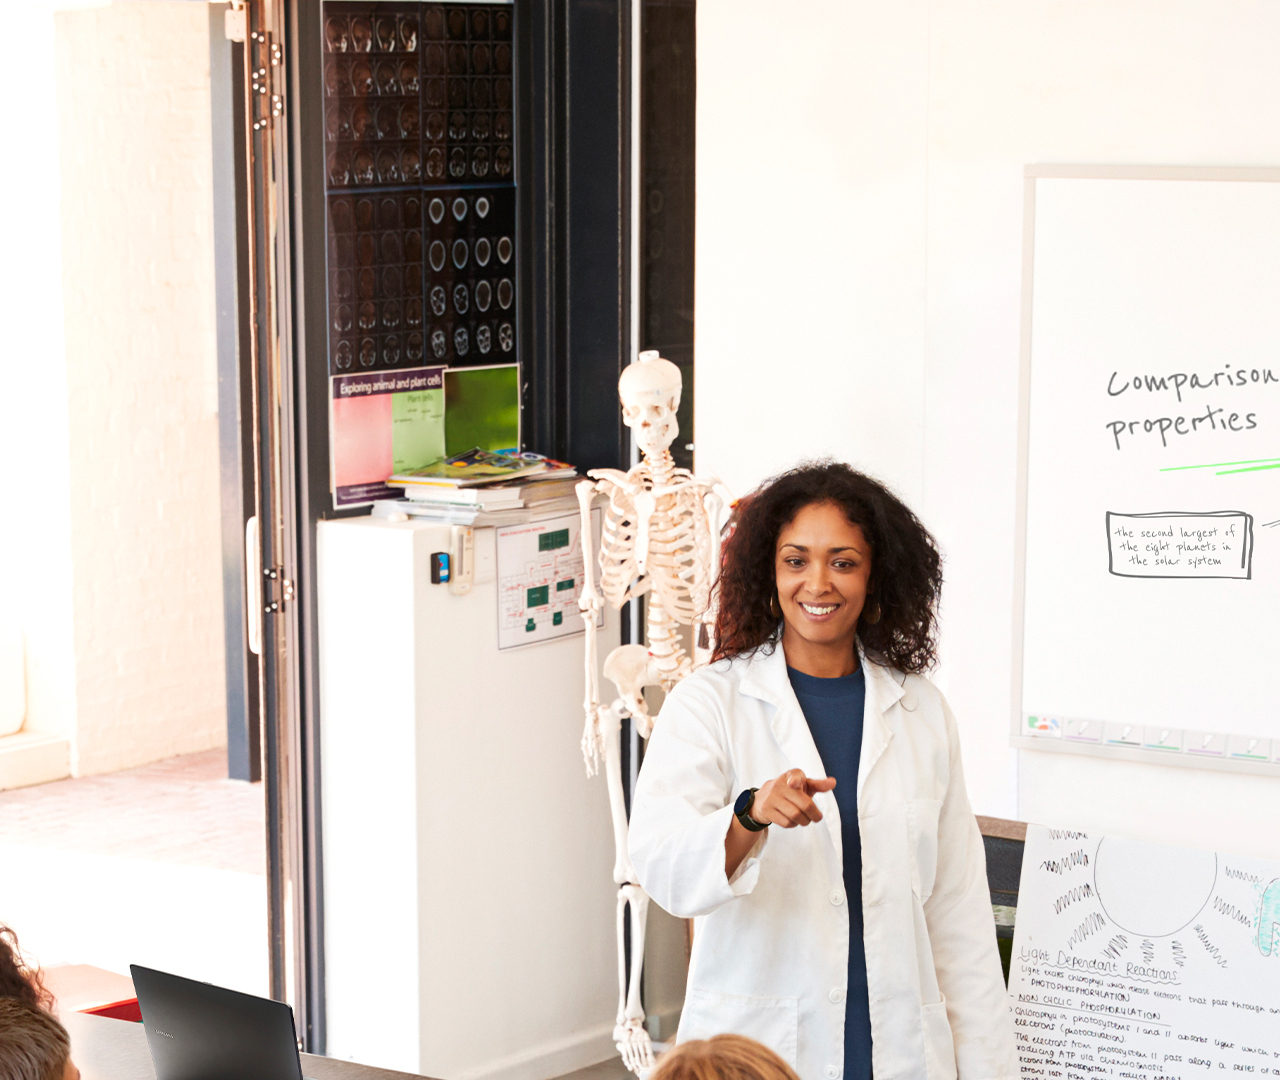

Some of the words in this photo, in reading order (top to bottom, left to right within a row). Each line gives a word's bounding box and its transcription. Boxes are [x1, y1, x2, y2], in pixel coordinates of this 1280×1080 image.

[340, 382, 371, 395] Exploring
[373, 379, 395, 390] animal
[396, 378, 409, 388] and
[411, 377, 426, 389] plant
[427, 374, 441, 386] cells
[1108, 363, 1279, 402] Comparison
[1107, 404, 1257, 450] properties
[1115, 527, 1135, 540] the
[1141, 527, 1174, 539] second
[1179, 527, 1218, 541] largest
[1224, 525, 1236, 540] of
[1119, 541, 1140, 552] the
[1146, 540, 1172, 555] eight
[1176, 540, 1216, 553] planets
[1221, 541, 1232, 551] in
[1129, 555, 1149, 567] the
[1154, 555, 1183, 567] solar
[1188, 555, 1222, 570] system
[1021, 946, 1050, 962] Light
[1057, 950, 1118, 972] Dependant
[1019, 994, 1039, 1003] NON
[1043, 997, 1072, 1006] CYCLIC
[1080, 1001, 1160, 1020] PHOSPHORYLATION
